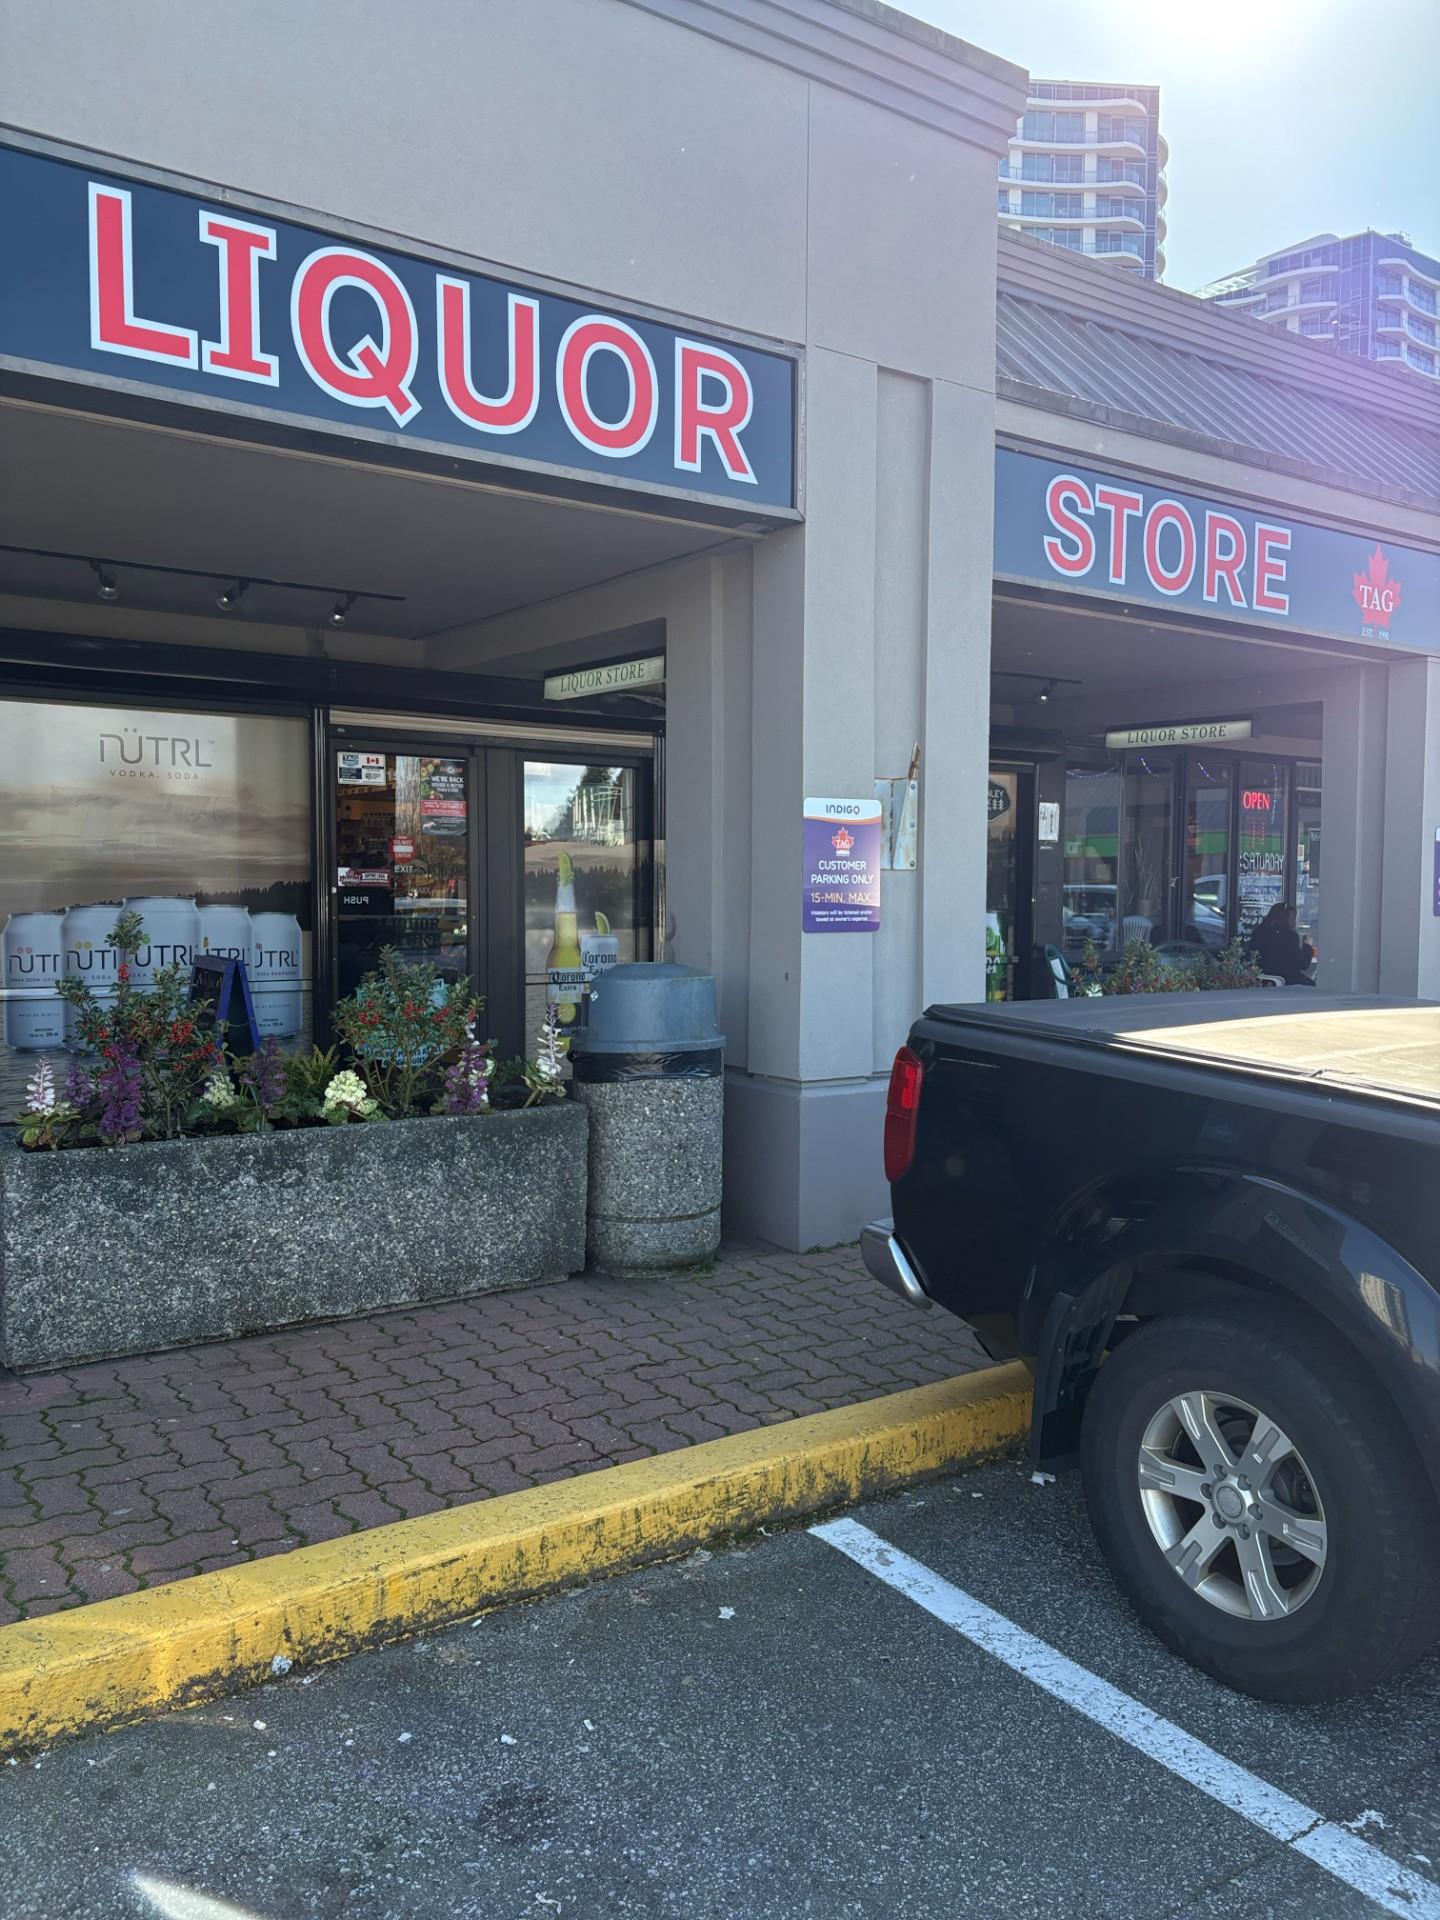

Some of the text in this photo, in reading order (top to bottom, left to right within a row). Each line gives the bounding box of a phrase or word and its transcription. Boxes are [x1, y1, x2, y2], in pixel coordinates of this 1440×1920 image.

[88, 181, 758, 485] LIQUOR
[1043, 474, 1292, 616] STORE
[1359, 585, 1394, 612] TAG
[560, 662, 646, 693] LIQUOR STORE
[1127, 725, 1227, 744] LIQUOR STORE
[166, 771, 200, 780] SODA
[449, 776, 464, 784] BACK
[1242, 791, 1270, 810] OPEN
[825, 804, 861, 815] INDIGO
[835, 839, 850, 848] TAG
[394, 864, 413, 873] EXIT
[818, 860, 867, 871] CUSTOMER
[810, 873, 874, 884] PARKING ONLY
